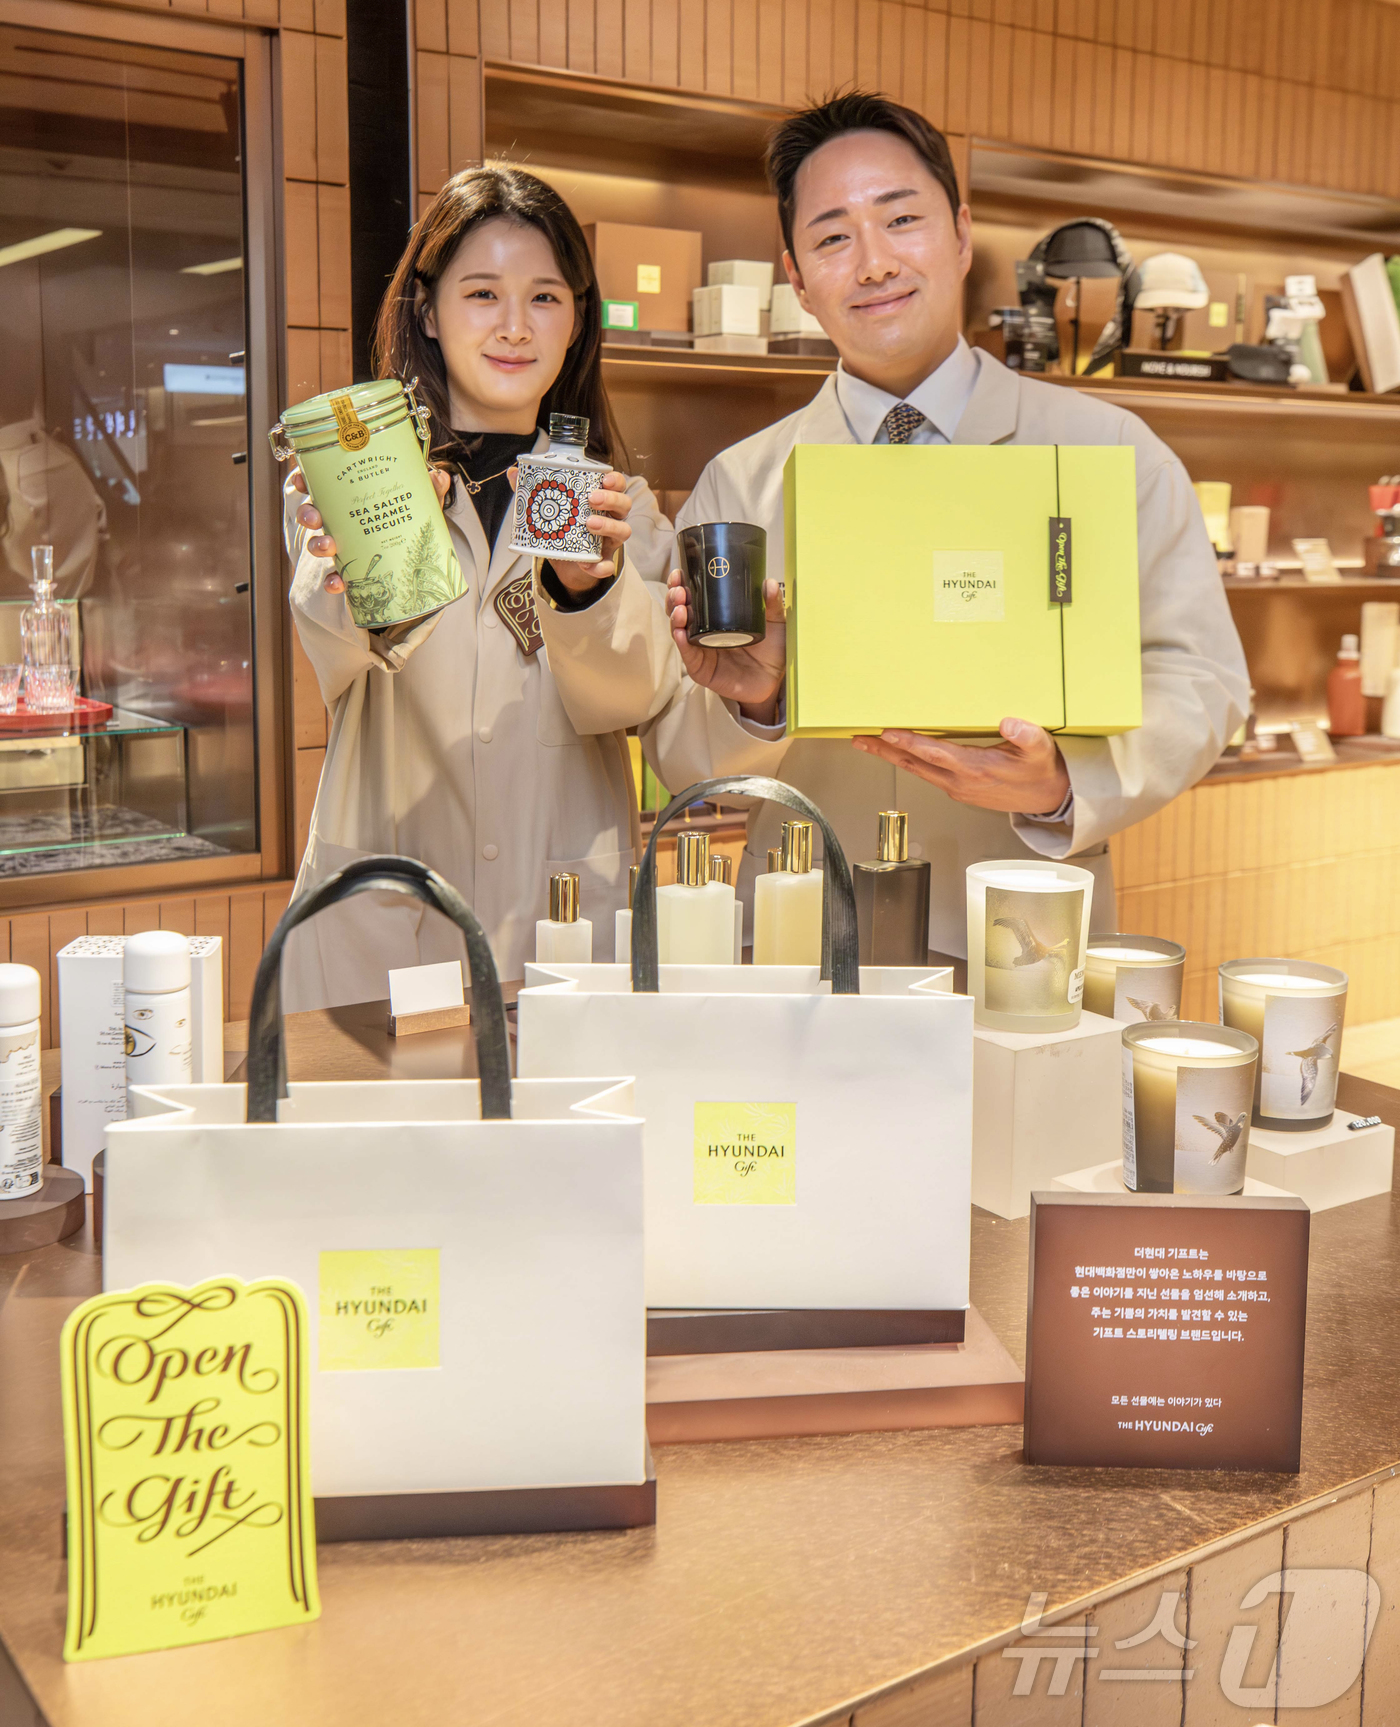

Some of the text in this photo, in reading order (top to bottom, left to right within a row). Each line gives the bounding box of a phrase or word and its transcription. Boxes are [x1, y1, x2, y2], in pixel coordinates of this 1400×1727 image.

[345, 430, 365, 442] C&B
[336, 455, 398, 481] CARTWRIGHT
[358, 467, 390, 482] BUTLER
[351, 481, 404, 505] Perfect Together
[349, 491, 413, 518] SEA SALTED
[359, 504, 411, 526] CARAMEL
[363, 513, 413, 536] BISCUITS
[943, 579, 996, 589] HYUNDAI
[737, 1133, 757, 1142] THE
[708, 1144, 785, 1158] HYUNDAI
[1134, 1246, 1209, 1261] 더현대 기프트는
[1074, 1265, 1268, 1282] 현대백화점만이 쌓아온 노하우를 바탕으로
[370, 1285, 394, 1297] THE
[1070, 1285, 1271, 1303] 좋은 이야기를 지닌 선물을 엄선해 소개하고,
[335, 1298, 428, 1316] HYUNDAI
[1091, 1306, 1249, 1323] 주는 기쁨의 가치를 발견할 수 있는
[1093, 1326, 1245, 1342] 기프트 스토리텔링 브랜드입니다.
[96, 1332, 279, 1404] Open
[1111, 1395, 1222, 1408] 모든 선물에는 이야기가 있다
[99, 1397, 281, 1457] The
[1118, 1421, 1134, 1429] THE
[1135, 1419, 1195, 1432] HYUNDAI
[100, 1464, 284, 1558] Gift
[183, 1574, 205, 1587] THE
[150, 1581, 238, 1611] HYUNDAI
